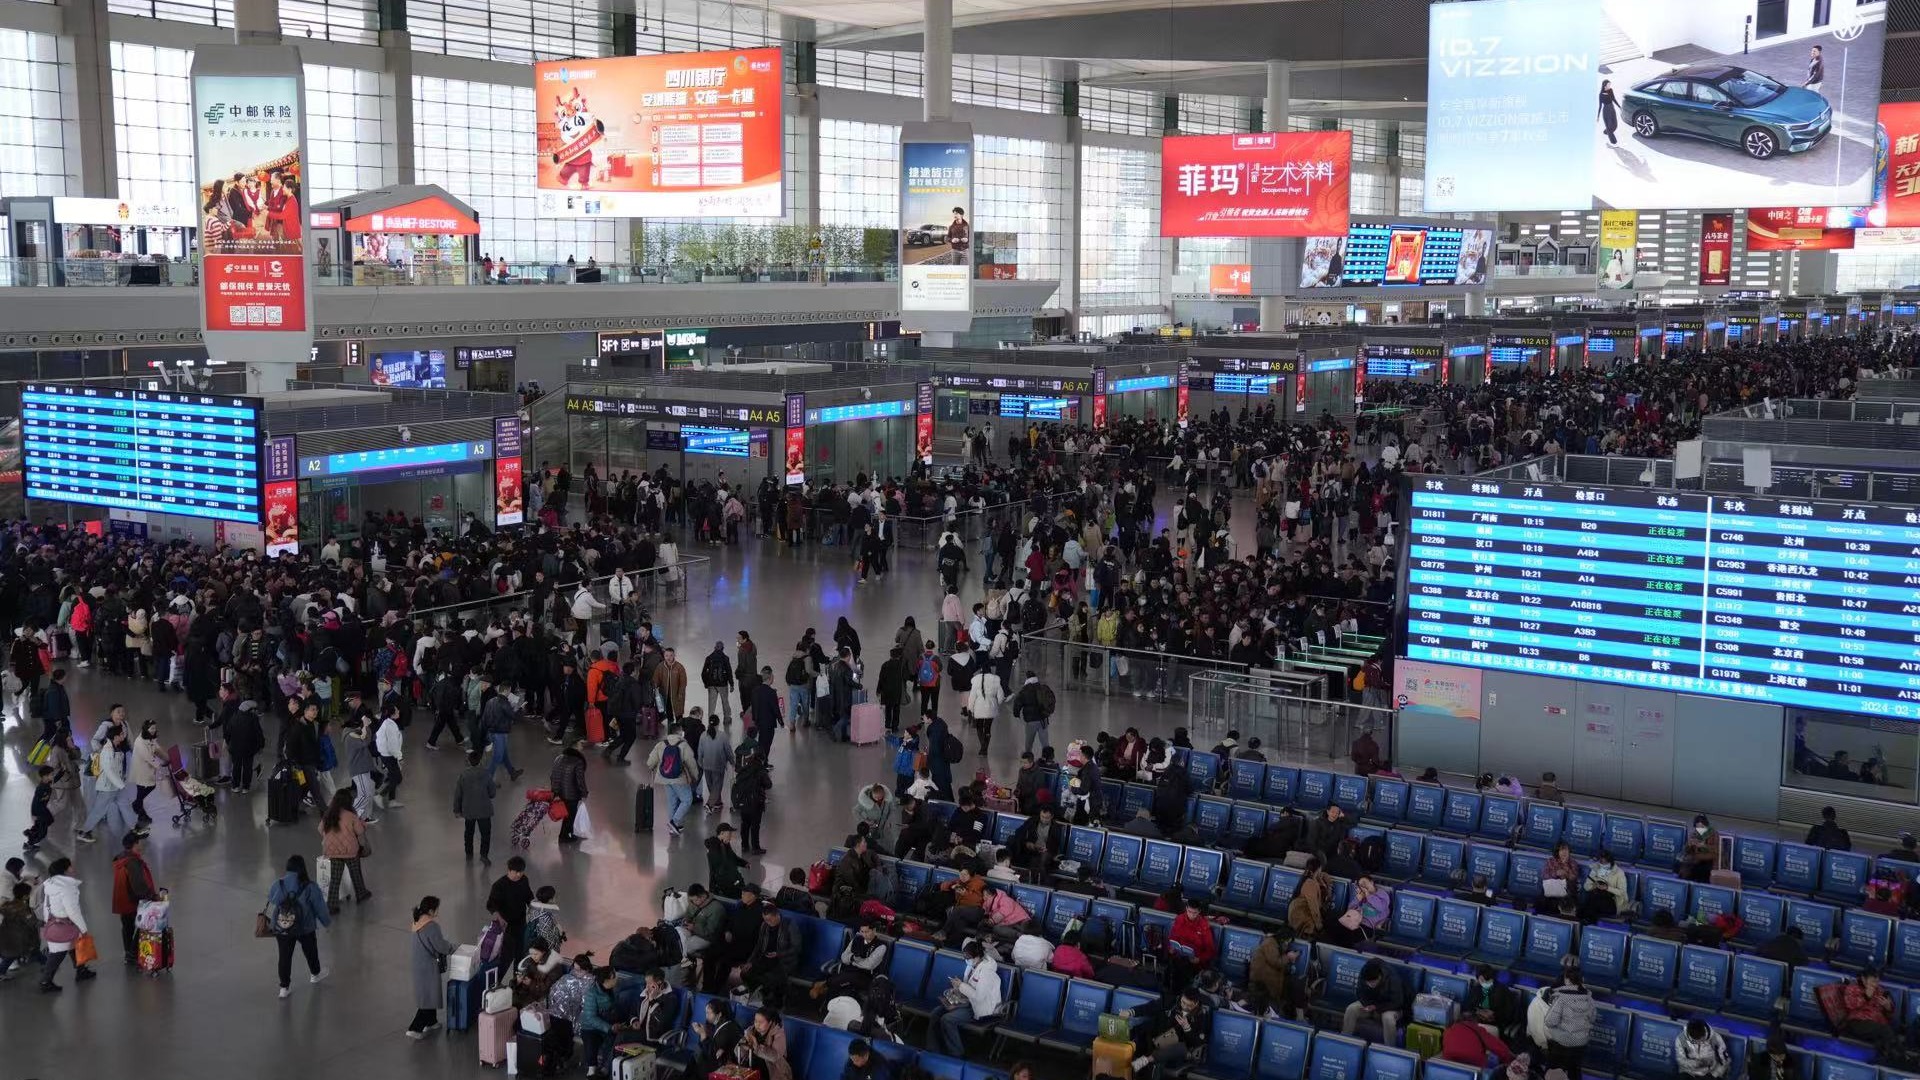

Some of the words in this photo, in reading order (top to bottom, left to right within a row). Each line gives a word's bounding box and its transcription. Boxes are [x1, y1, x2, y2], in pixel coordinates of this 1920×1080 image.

[1439, 36, 1502, 57] ID.7
[1439, 53, 1589, 78] VIZZION
[665, 67, 727, 89] 四川银行
[230, 104, 292, 118] 中邮保险
[1895, 133, 1920, 156] 新
[1178, 163, 1240, 197] 菲玛
[1261, 161, 1335, 196] 艺术涂料
[419, 219, 458, 229] BESTORE
[601, 339, 613, 352] 3F
[1410, 346, 1425, 356] A10
[1426, 347, 1440, 356] A11
[1521, 337, 1535, 345] A12
[1535, 337, 1550, 346] A13
[1270, 361, 1281, 371] A8
[1283, 362, 1295, 372] A9
[1062, 381, 1075, 392] A6
[1076, 382, 1089, 392] A7
[567, 398, 580, 410] A4
[582, 400, 595, 412] A5
[749, 410, 763, 422] A4
[766, 411, 780, 422] A5
[473, 444, 485, 455] A3
[308, 460, 321, 472] A2
[1425, 480, 1444, 491] 车次
[1471, 483, 1500, 495] 终到站
[1523, 487, 1543, 498] 开点
[1575, 490, 1605, 501] 检票口
[1657, 495, 1678, 507] 状态
[1723, 500, 1746, 512] 车次
[1779, 504, 1814, 517] 终到站
[1842, 509, 1866, 520] 开点
[1905, 512, 1920, 524] 检
[1423, 510, 1445, 518] D1811
[1472, 513, 1498, 523] 广州南
[1523, 518, 1545, 526] 10:15
[1581, 522, 1597, 530] B20
[1648, 526, 1686, 537] 正在检票
[1422, 535, 1445, 545] D2260
[1475, 539, 1493, 548] 汉口
[1522, 544, 1543, 552] 10:18
[1577, 549, 1599, 557] A4B4
[1647, 554, 1685, 565] 正在检票
[1721, 533, 1744, 542] C746
[1783, 536, 1805, 547] 达州
[1845, 542, 1871, 552] 10:39
[1420, 560, 1445, 569] G8775
[1474, 565, 1493, 574] 泸州
[1521, 570, 1541, 578] 10:21
[1578, 575, 1595, 583] A14
[1646, 581, 1683, 592] 正在检票
[1716, 560, 1746, 570] G2963
[1767, 563, 1819, 577] 香港西九龙
[1843, 571, 1869, 581] 10:42
[1422, 586, 1442, 595] G388
[1465, 589, 1500, 601] 北京丰台
[1520, 596, 1542, 604] 10:22
[1570, 601, 1602, 610] A16B16
[1644, 607, 1682, 619] 正在检票
[1716, 587, 1743, 597] C5991
[1776, 592, 1807, 603] 贵阳北
[1842, 600, 1867, 609] 10:47
[1421, 611, 1441, 620] C788
[1473, 616, 1491, 625] 达州
[1519, 622, 1540, 630] 10:27
[1574, 628, 1596, 636] A3B3
[1643, 634, 1681, 646] 正在检票
[1715, 615, 1742, 625] C3348
[1779, 620, 1800, 631] 雅安
[1840, 627, 1866, 637] 10:48
[1421, 636, 1440, 644] C704
[1471, 640, 1488, 650] 阆中
[1519, 647, 1539, 655] 10:33
[1579, 653, 1590, 661] B6
[1651, 661, 1671, 671] 候车
[1715, 642, 1739, 652] G308
[1773, 648, 1804, 660] 北京西
[1711, 669, 1740, 679] G1976
[1767, 674, 1807, 687] 上海虹桥
[1837, 683, 1862, 693] 11:01
